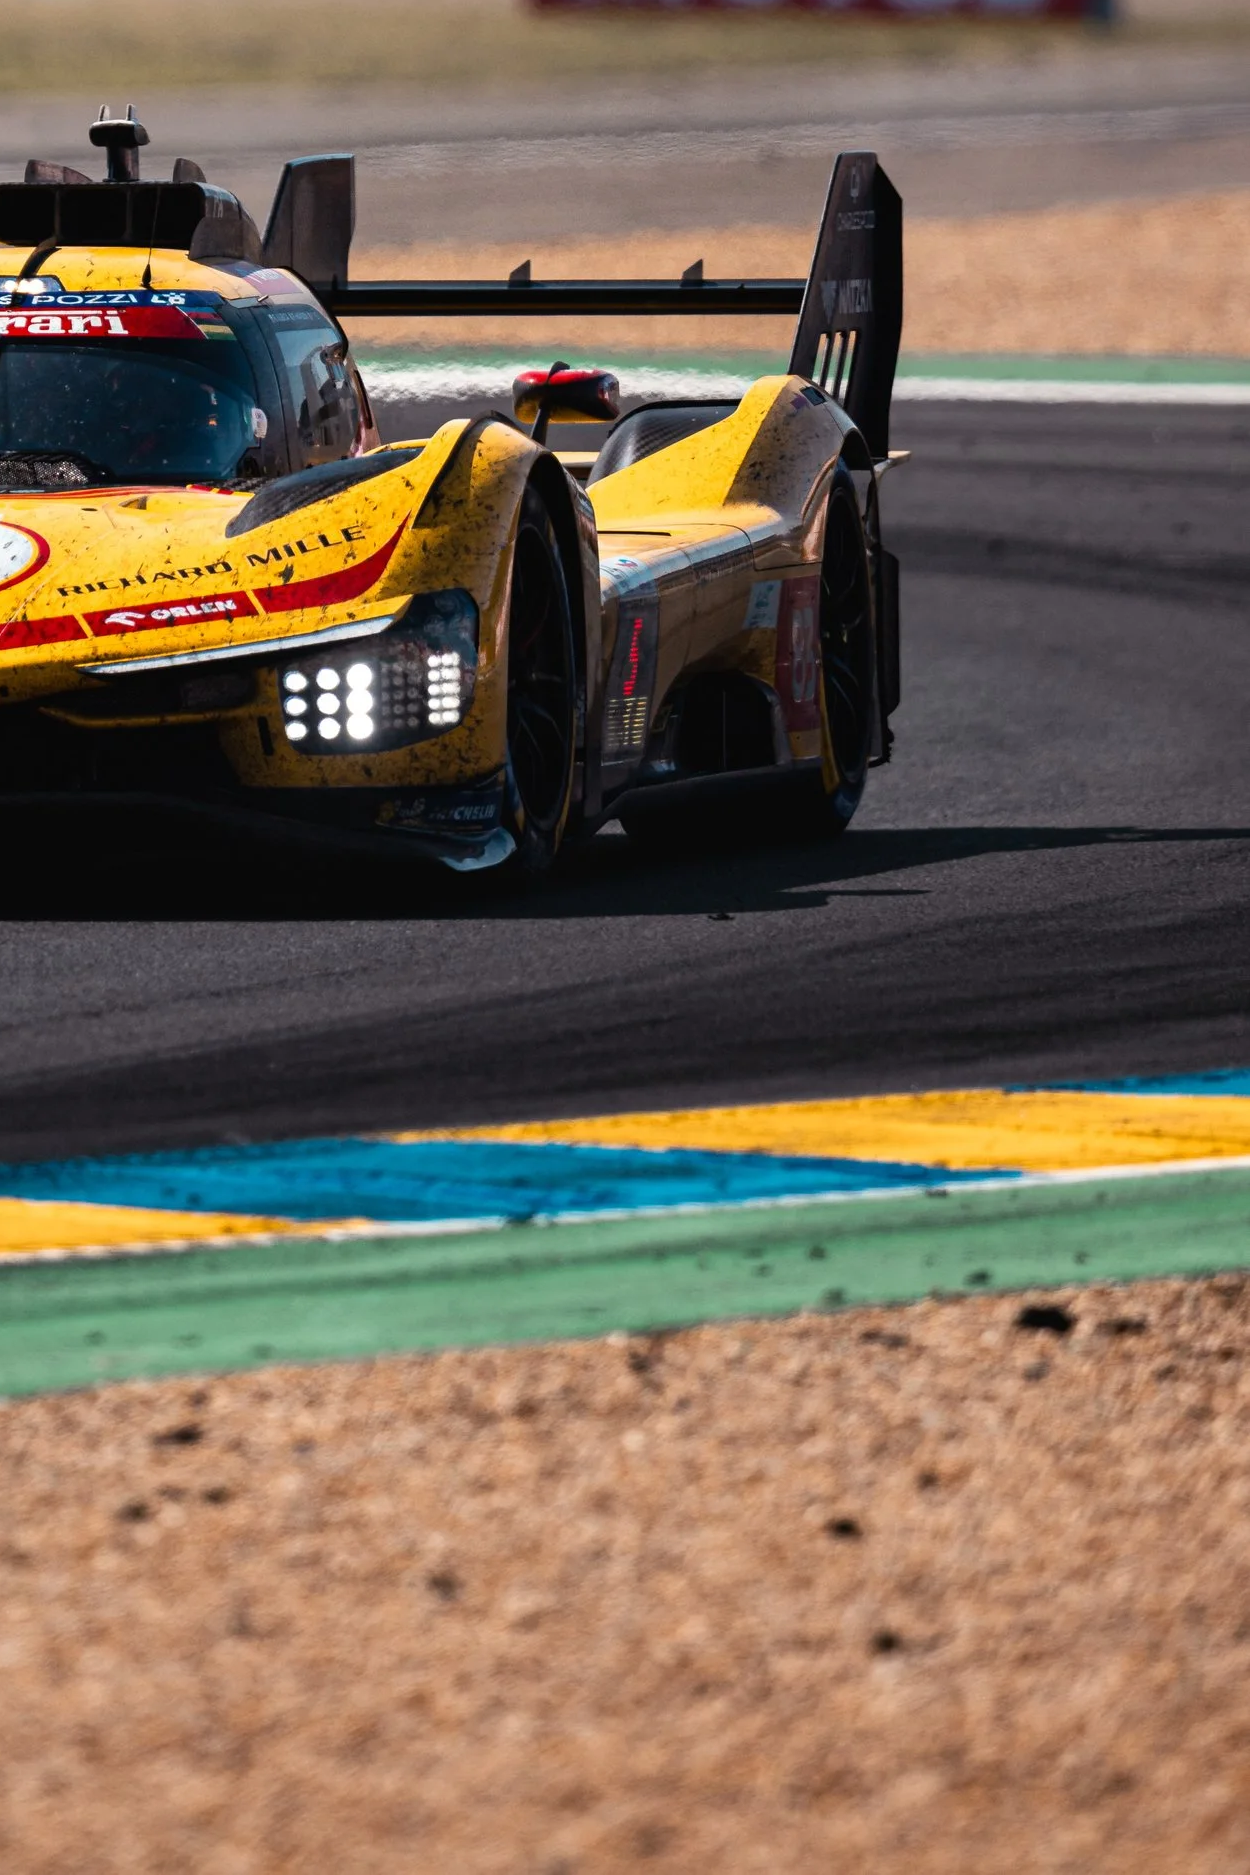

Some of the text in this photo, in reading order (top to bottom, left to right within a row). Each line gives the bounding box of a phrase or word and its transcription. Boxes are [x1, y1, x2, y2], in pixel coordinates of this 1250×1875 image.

[31, 293, 138, 305] POZZI
[56, 525, 366, 597] RICHARD MILLE
[150, 599, 237, 621] ORLEN
